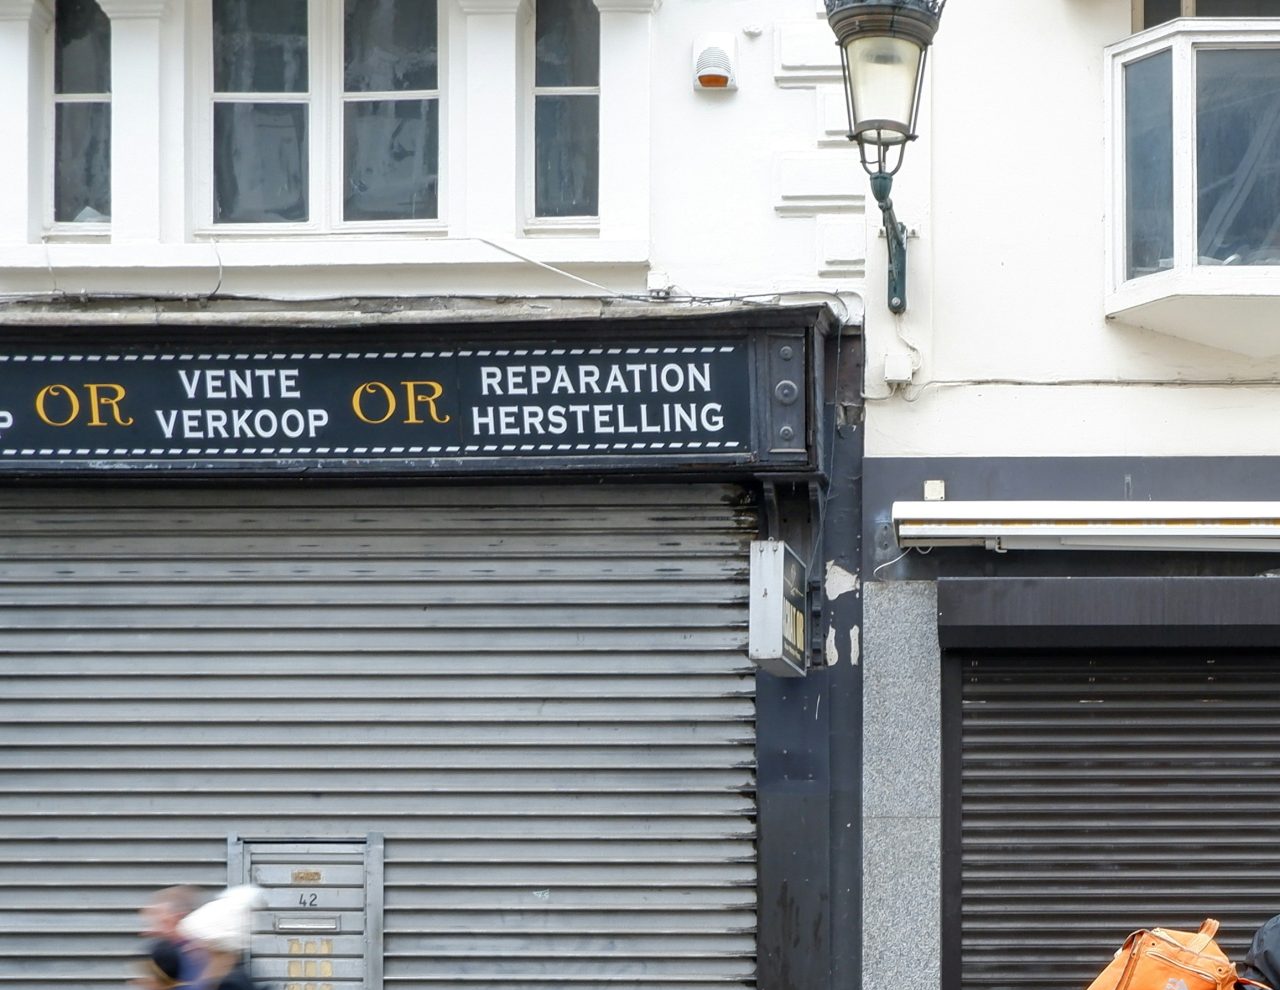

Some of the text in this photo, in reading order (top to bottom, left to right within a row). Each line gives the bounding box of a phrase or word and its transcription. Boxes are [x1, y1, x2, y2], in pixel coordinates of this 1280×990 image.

[178, 368, 301, 400] VENTE
[480, 362, 712, 397] REPARATION
[35, 383, 134, 427] OR
[351, 380, 451, 424] OR
[472, 402, 725, 436] HERSTELLING
[155, 408, 329, 439] VERKOOP
[298, 892, 318, 907] 42
